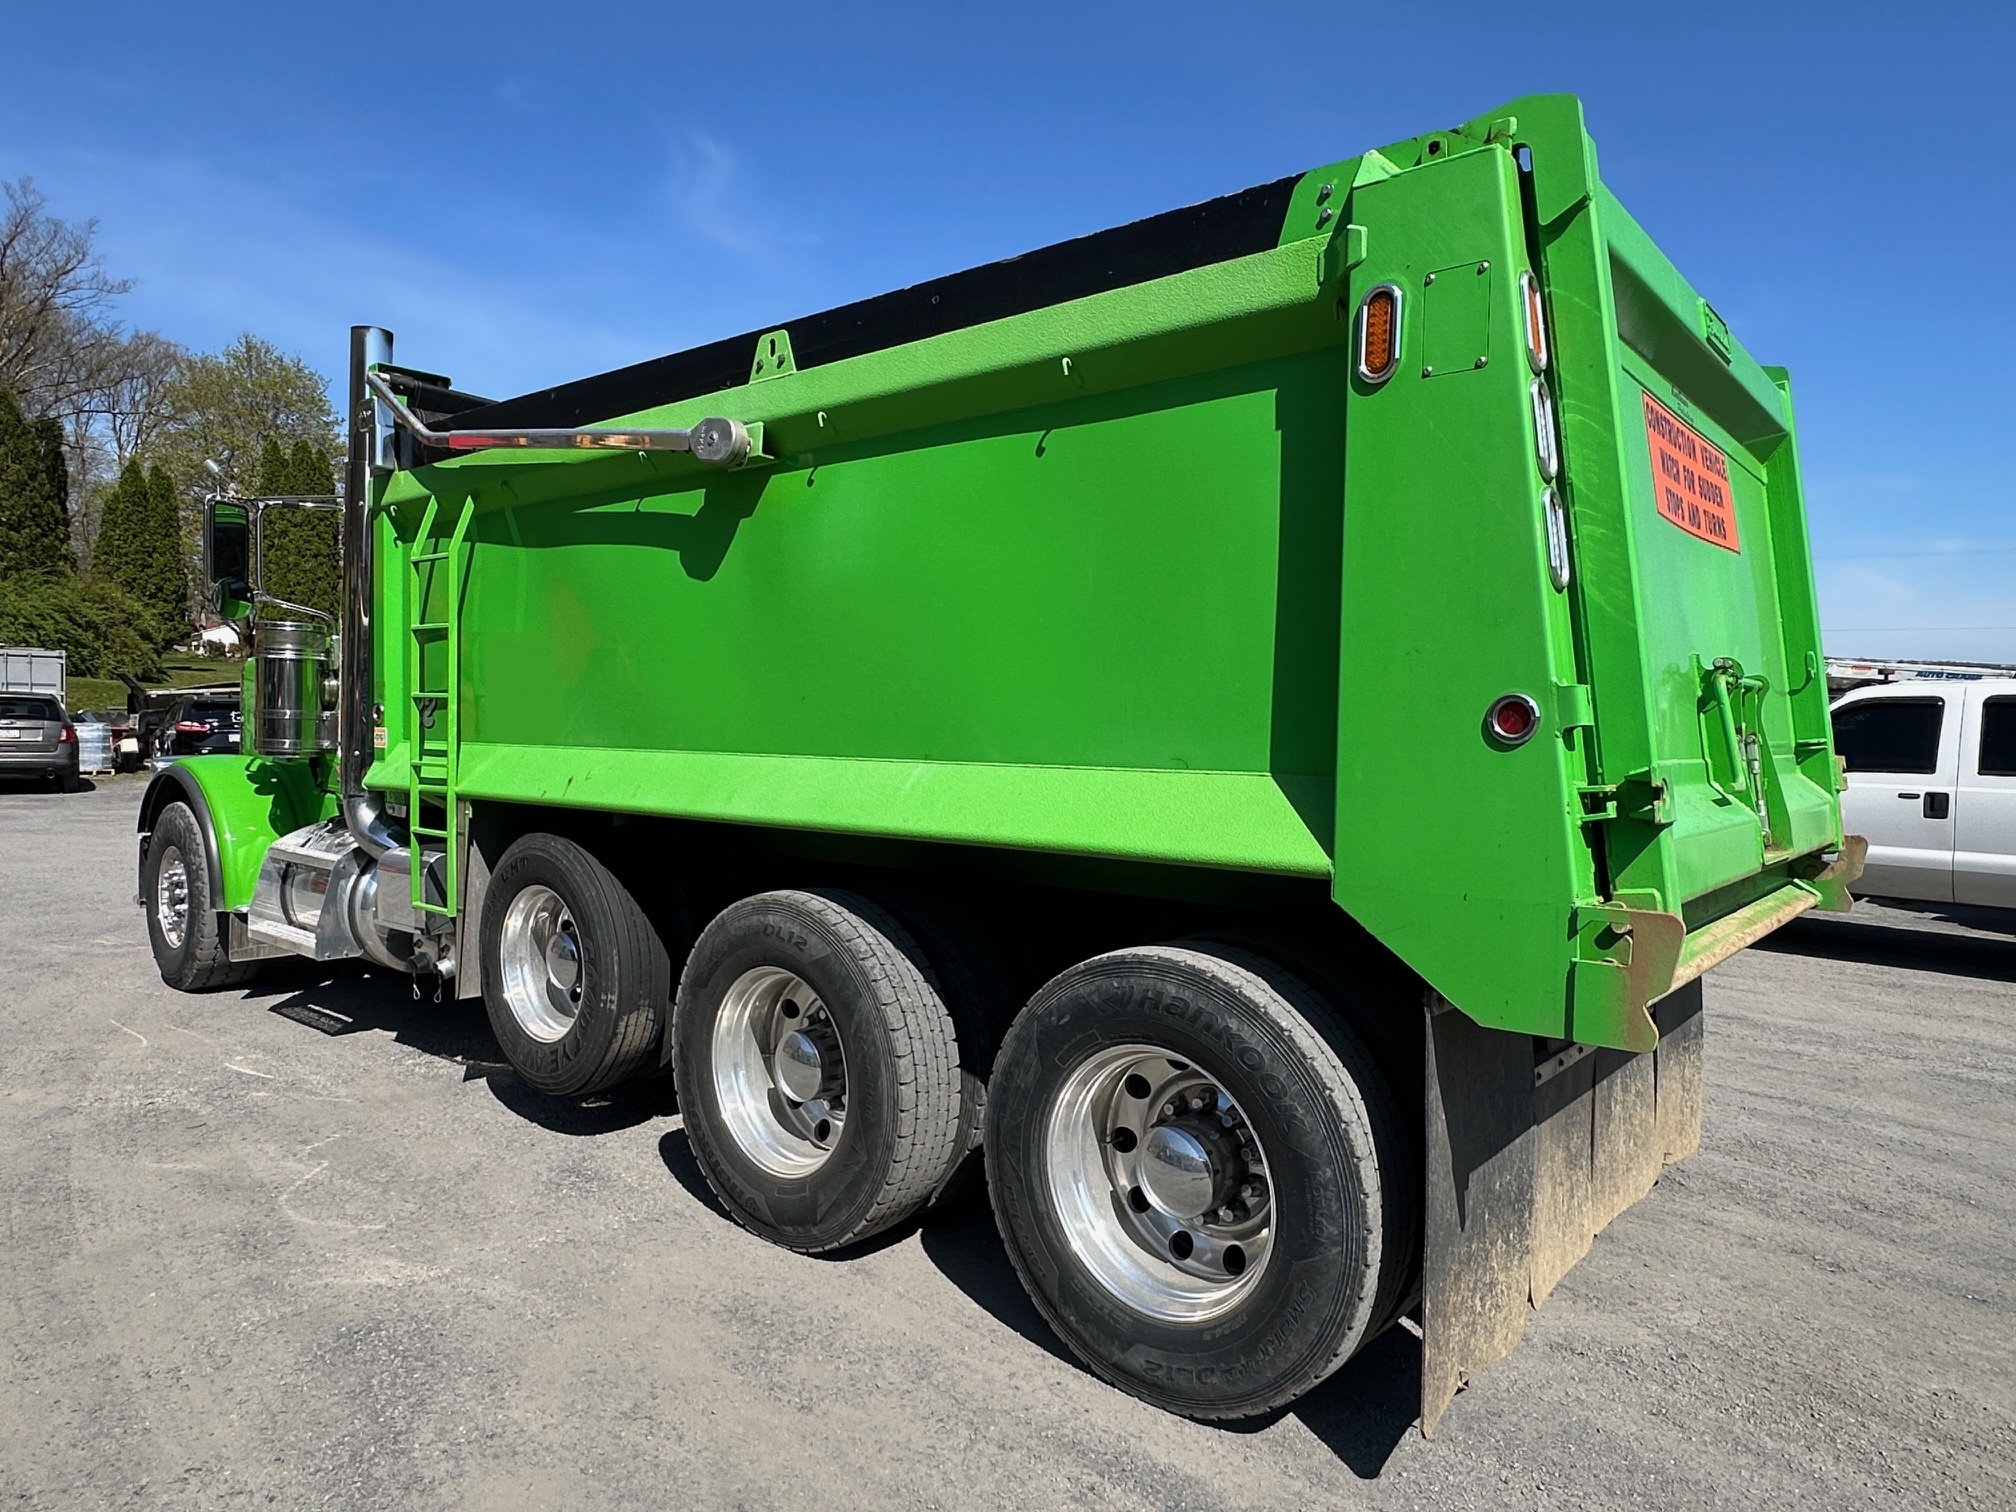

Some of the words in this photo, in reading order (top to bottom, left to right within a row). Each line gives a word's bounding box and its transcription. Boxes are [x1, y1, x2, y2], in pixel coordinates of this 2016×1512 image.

[1645, 401, 1698, 463] CONSTRUCTION
[1699, 443, 1728, 483] VEHICLE
[1659, 446, 1681, 486] WATCH
[1683, 464, 1696, 496] FOR
[1698, 474, 1724, 510] SUDDEN
[1665, 485, 1686, 522] STOPS
[1687, 500, 1702, 531] AND
[1703, 508, 1728, 541] TURNS
